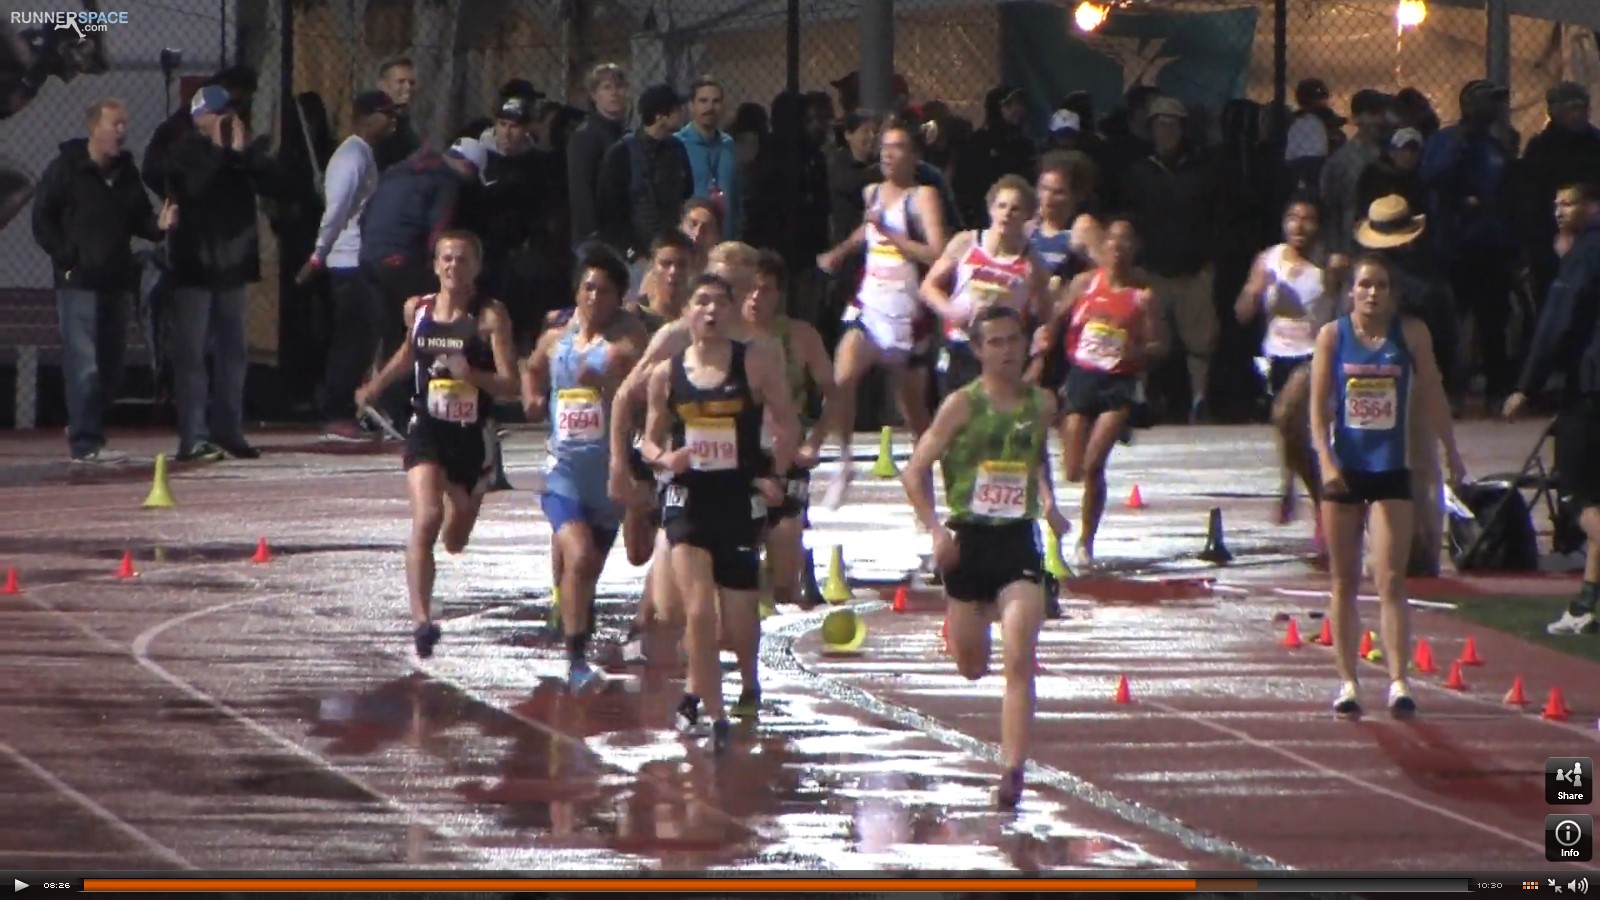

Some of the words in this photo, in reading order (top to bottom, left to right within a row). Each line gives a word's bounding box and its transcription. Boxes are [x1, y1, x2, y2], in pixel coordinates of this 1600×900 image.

[1349, 398, 1393, 419] 3564
[559, 411, 600, 430] 2694
[978, 484, 1024, 506] 3372
